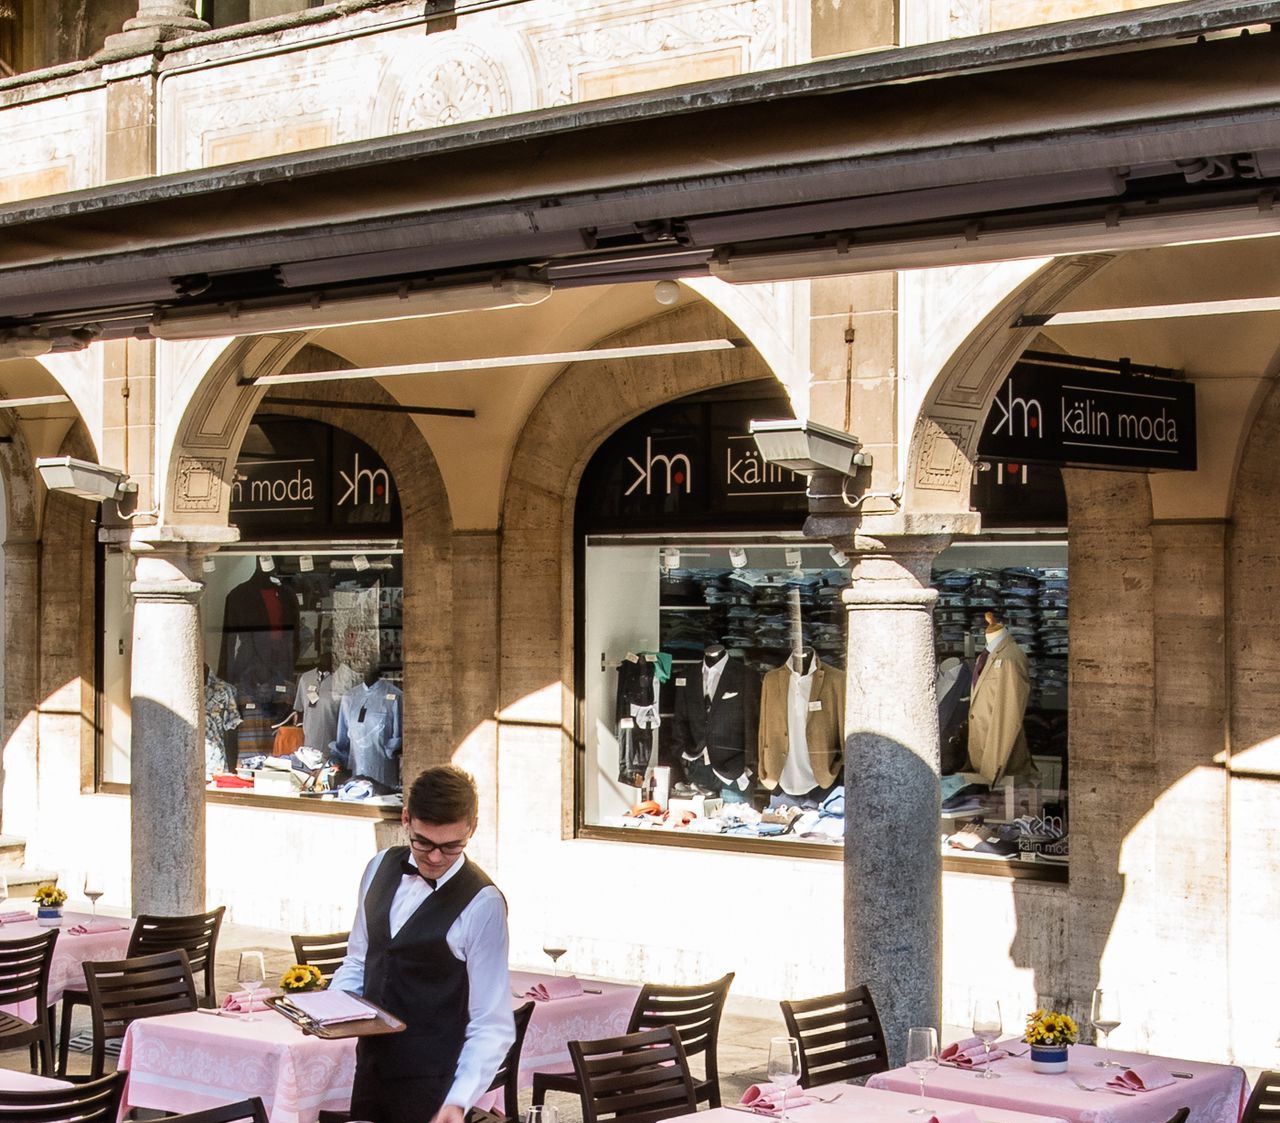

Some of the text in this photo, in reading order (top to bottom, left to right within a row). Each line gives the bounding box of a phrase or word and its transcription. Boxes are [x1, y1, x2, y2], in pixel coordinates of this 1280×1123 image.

[1061, 396, 1110, 437] kälin
[1118, 407, 1178, 443] moda
[251, 469, 314, 501] moda
